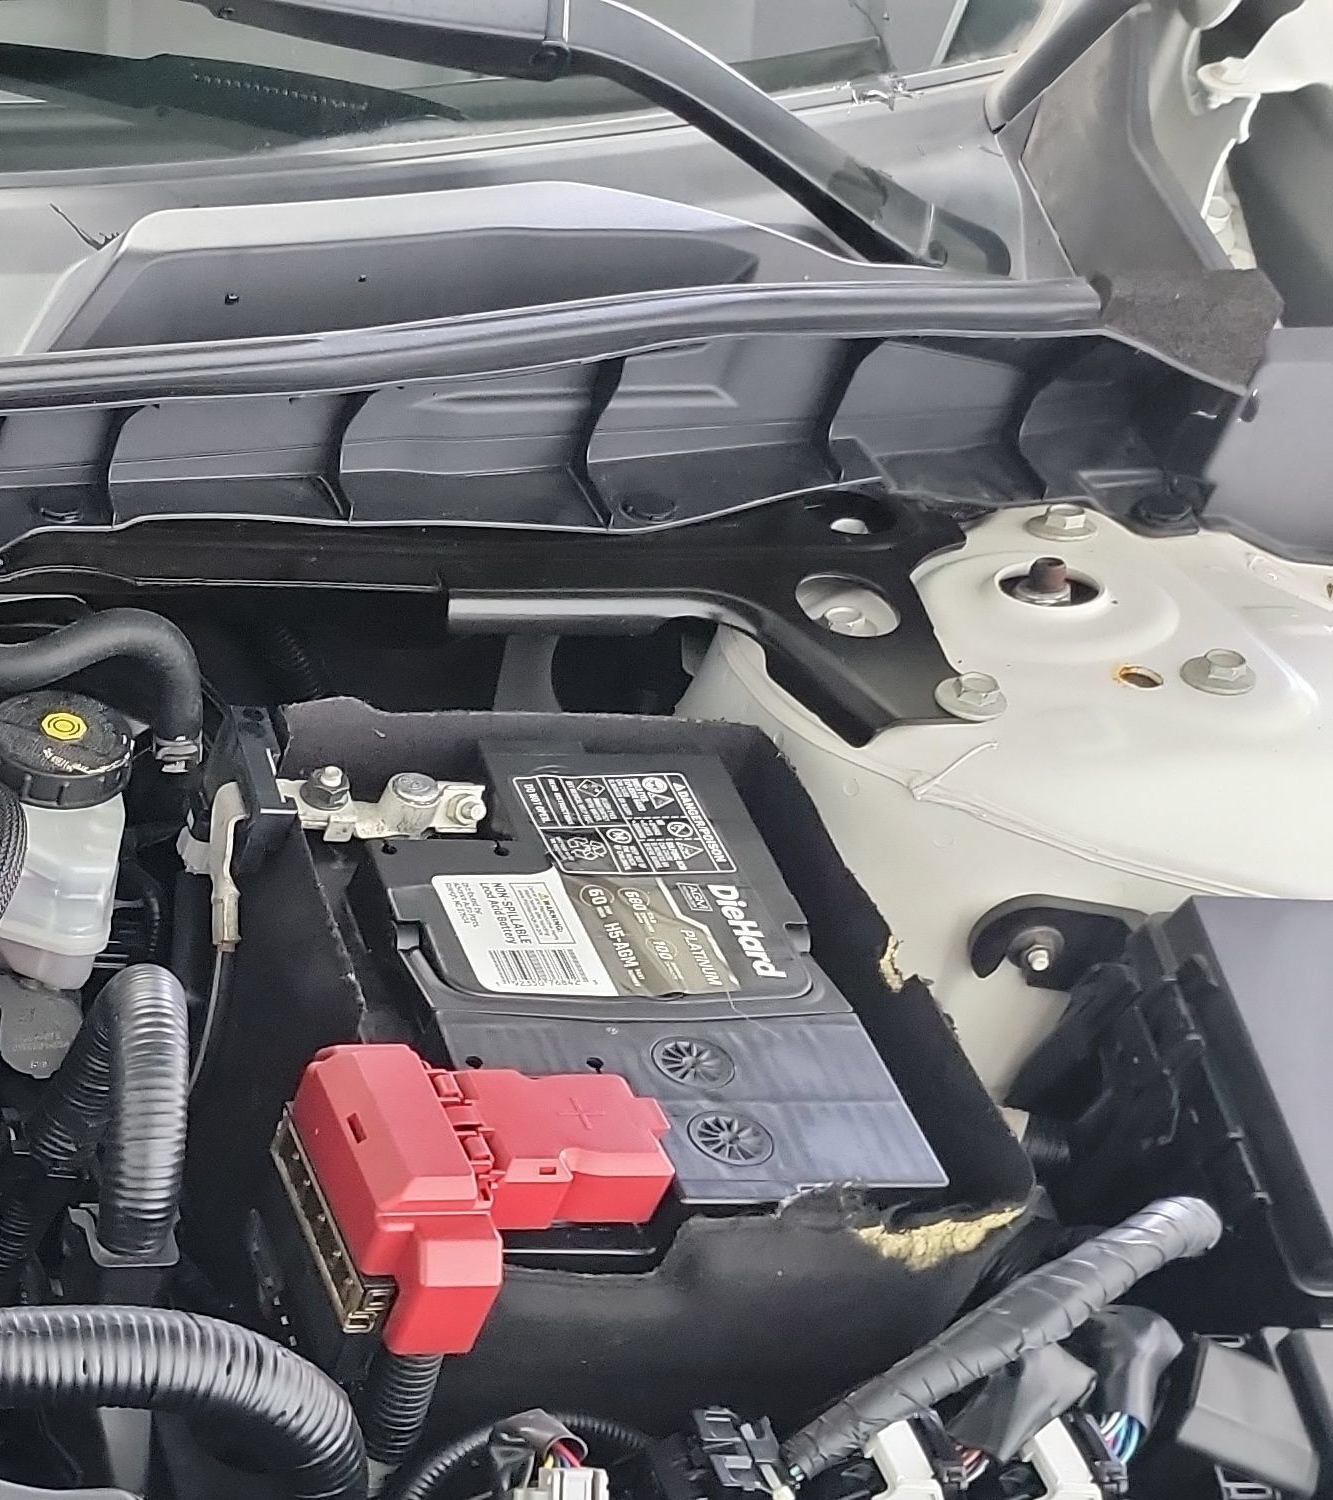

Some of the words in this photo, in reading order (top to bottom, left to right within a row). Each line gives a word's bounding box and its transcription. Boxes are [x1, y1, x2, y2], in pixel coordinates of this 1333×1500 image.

[492, 883, 532, 944] NON-SPILLABLE
[588, 888, 606, 905] 60
[624, 891, 646, 911] 680
[686, 885, 708, 910] AGM
[489, 899, 503, 917] Acid
[497, 914, 516, 944] Battery
[708, 885, 787, 979] DieHard
[604, 923, 639, 968] H5-AGM
[652, 940, 672, 960] 100
[680, 929, 723, 986] PLATINUM
